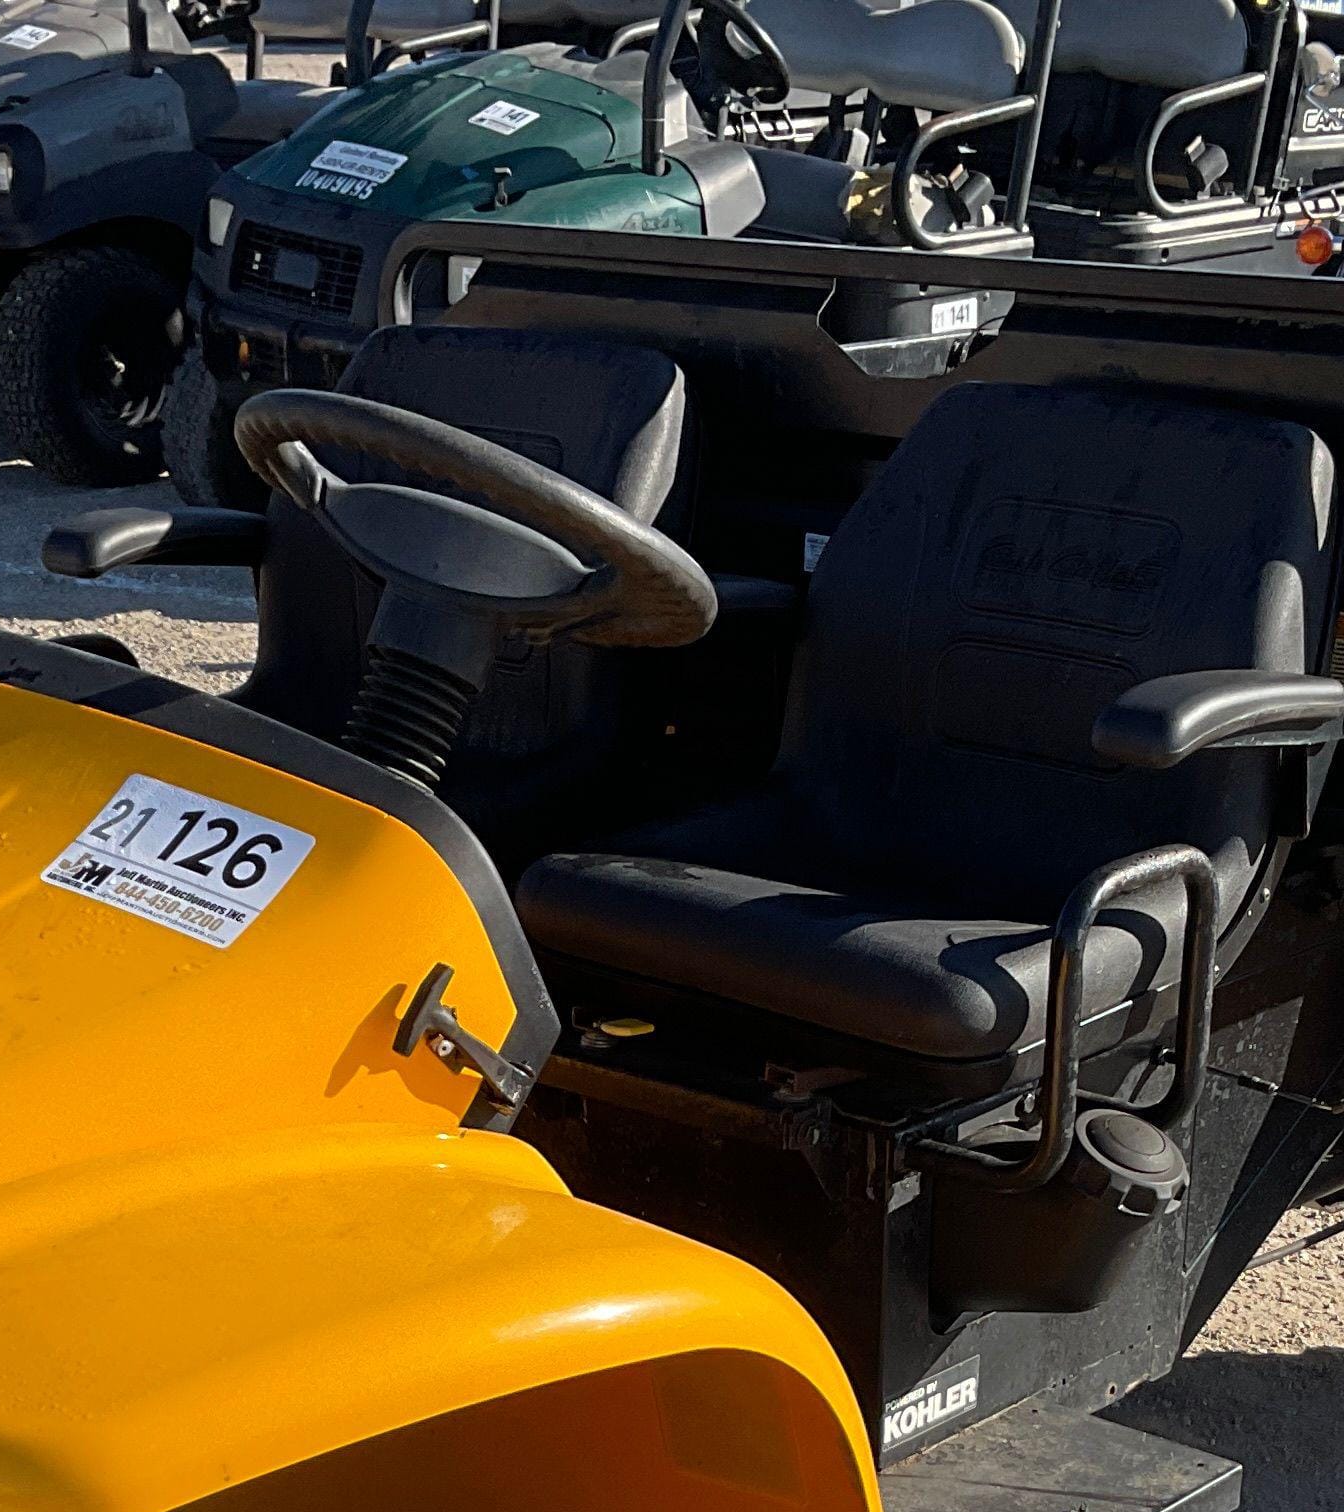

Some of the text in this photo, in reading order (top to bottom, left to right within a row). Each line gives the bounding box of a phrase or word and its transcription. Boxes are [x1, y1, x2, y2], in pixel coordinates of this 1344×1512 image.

[502, 108, 531, 124] 141
[294, 168, 377, 200] 10409095
[950, 303, 970, 326] 141
[87, 797, 283, 889] 21 126
[113, 880, 226, 933] 844-450-6200
[135, 872, 169, 893] Martin
[166, 885, 230, 915] Auctioneers
[883, 1377, 977, 1444] KOHLER
[885, 1387, 925, 1413] POWERED
